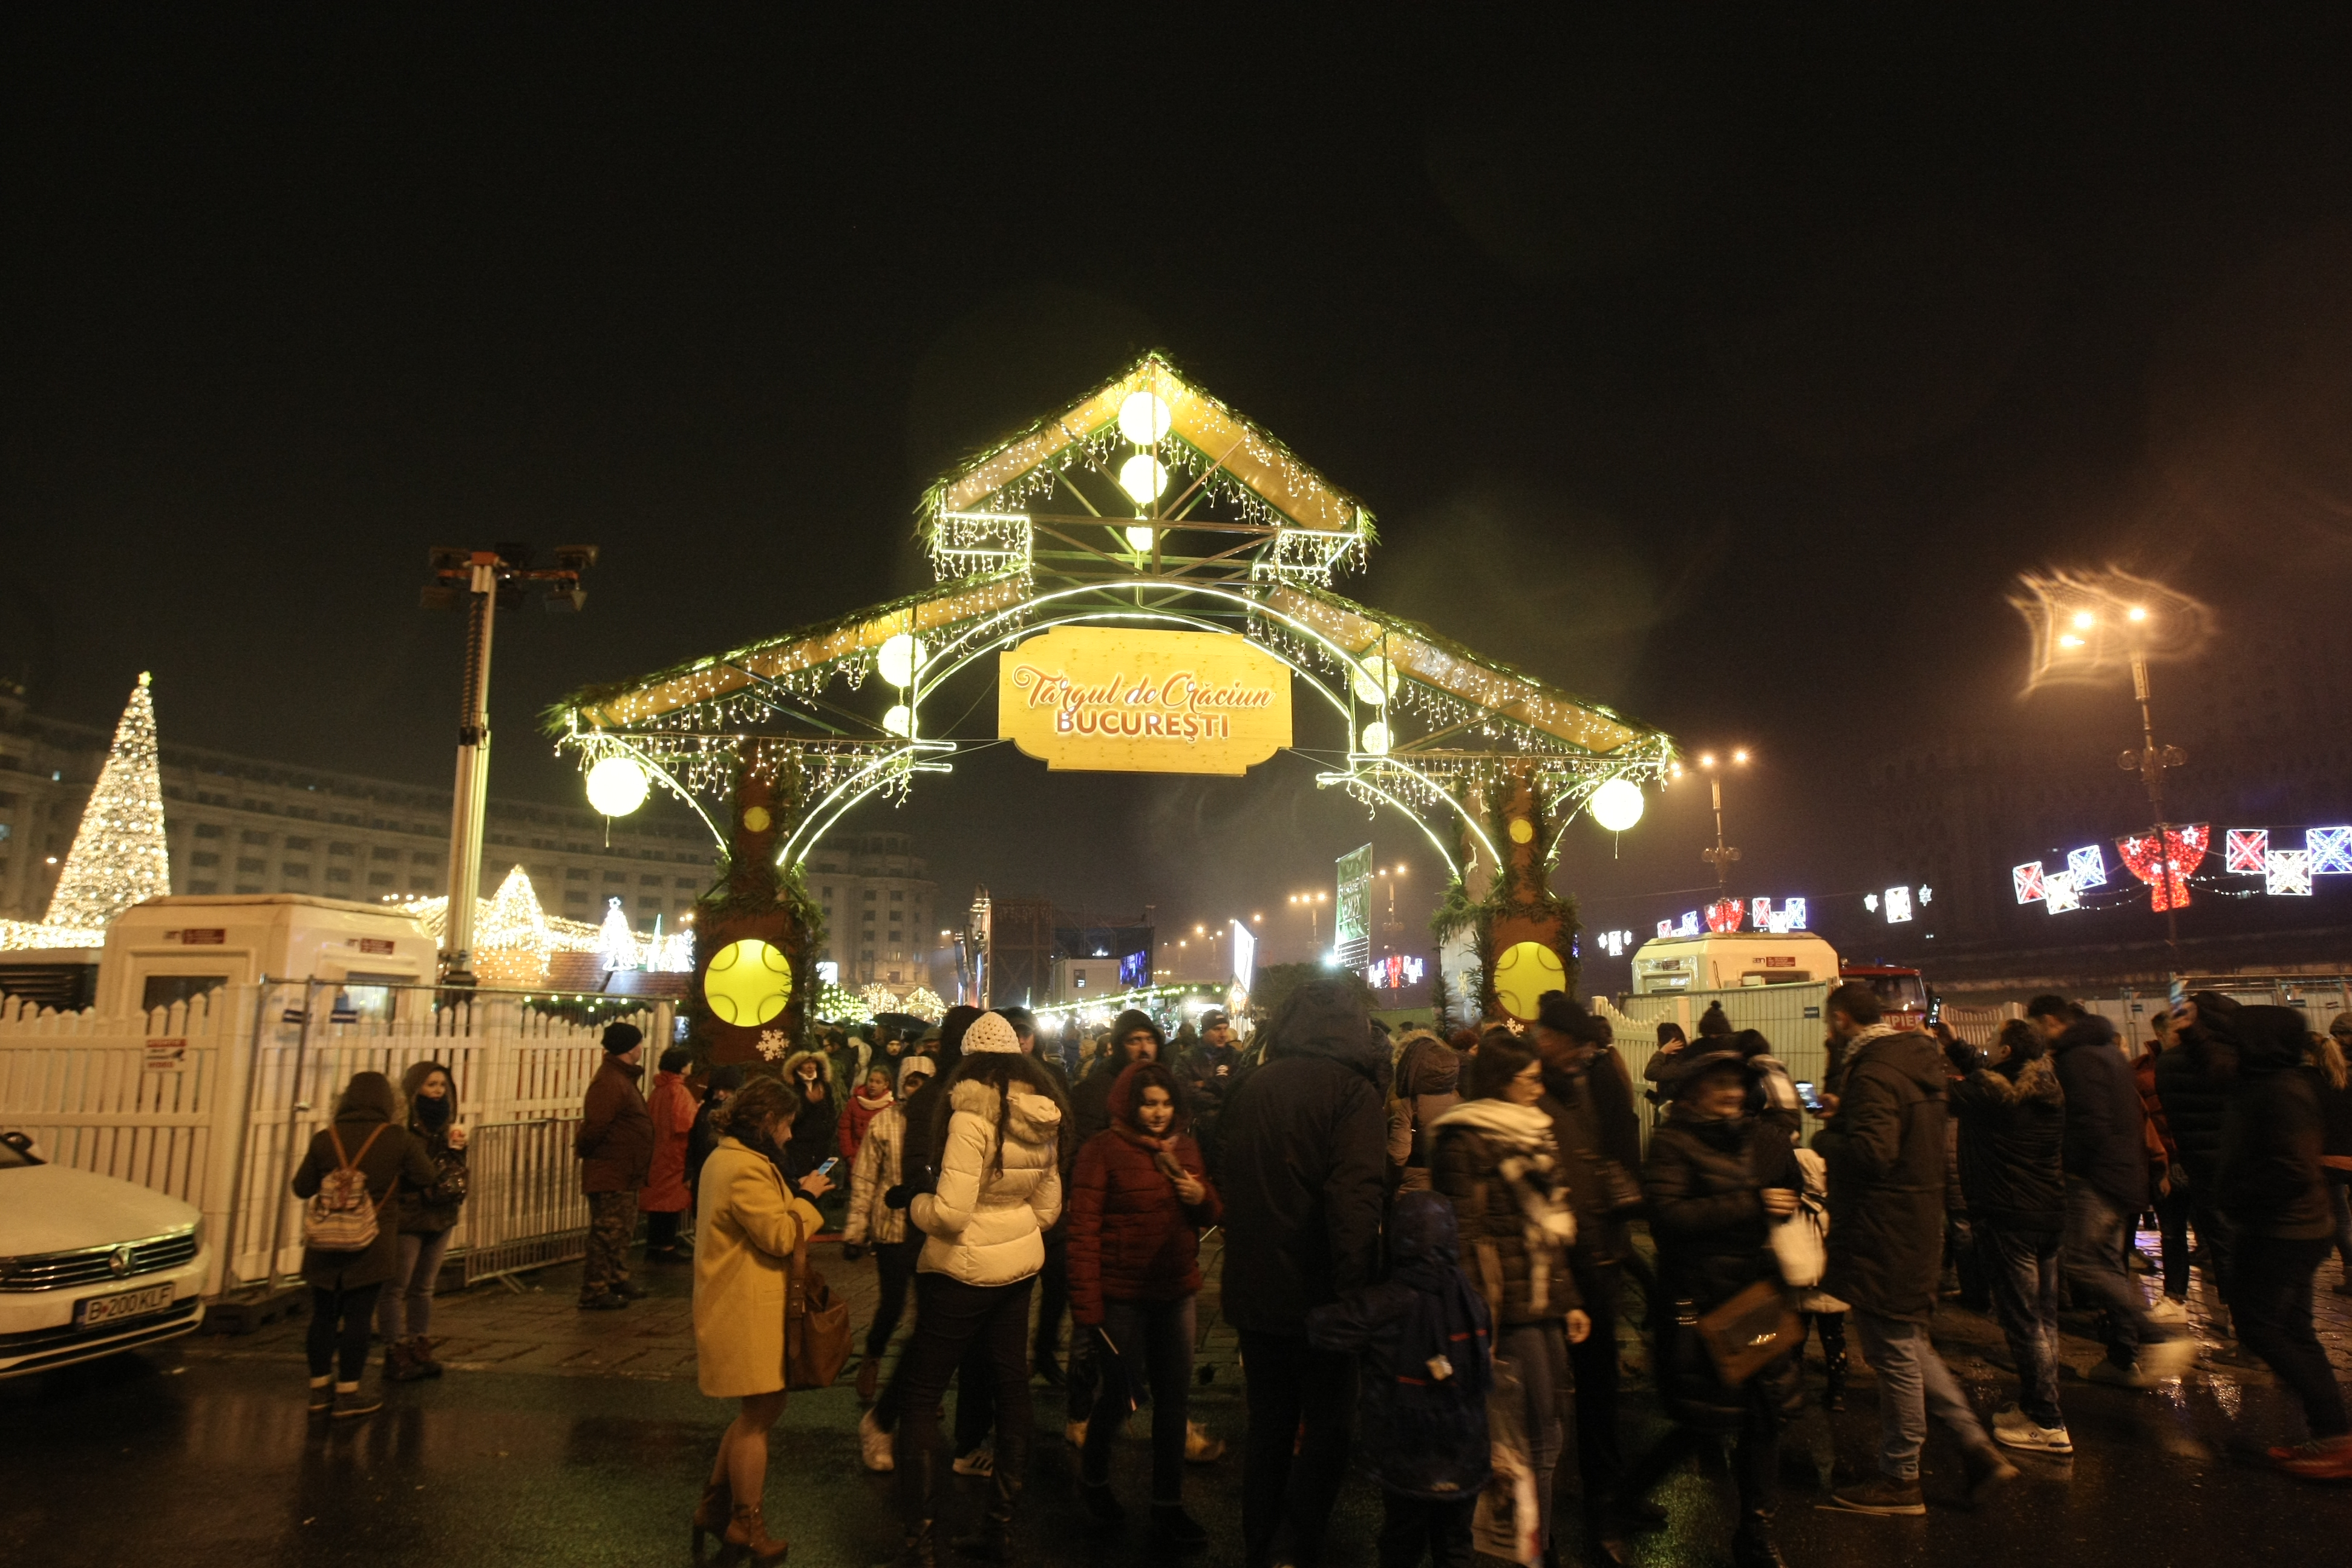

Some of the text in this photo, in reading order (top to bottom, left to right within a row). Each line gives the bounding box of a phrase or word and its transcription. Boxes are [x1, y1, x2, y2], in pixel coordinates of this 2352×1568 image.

[1013, 665, 1275, 716] Târgul de Crăciun
